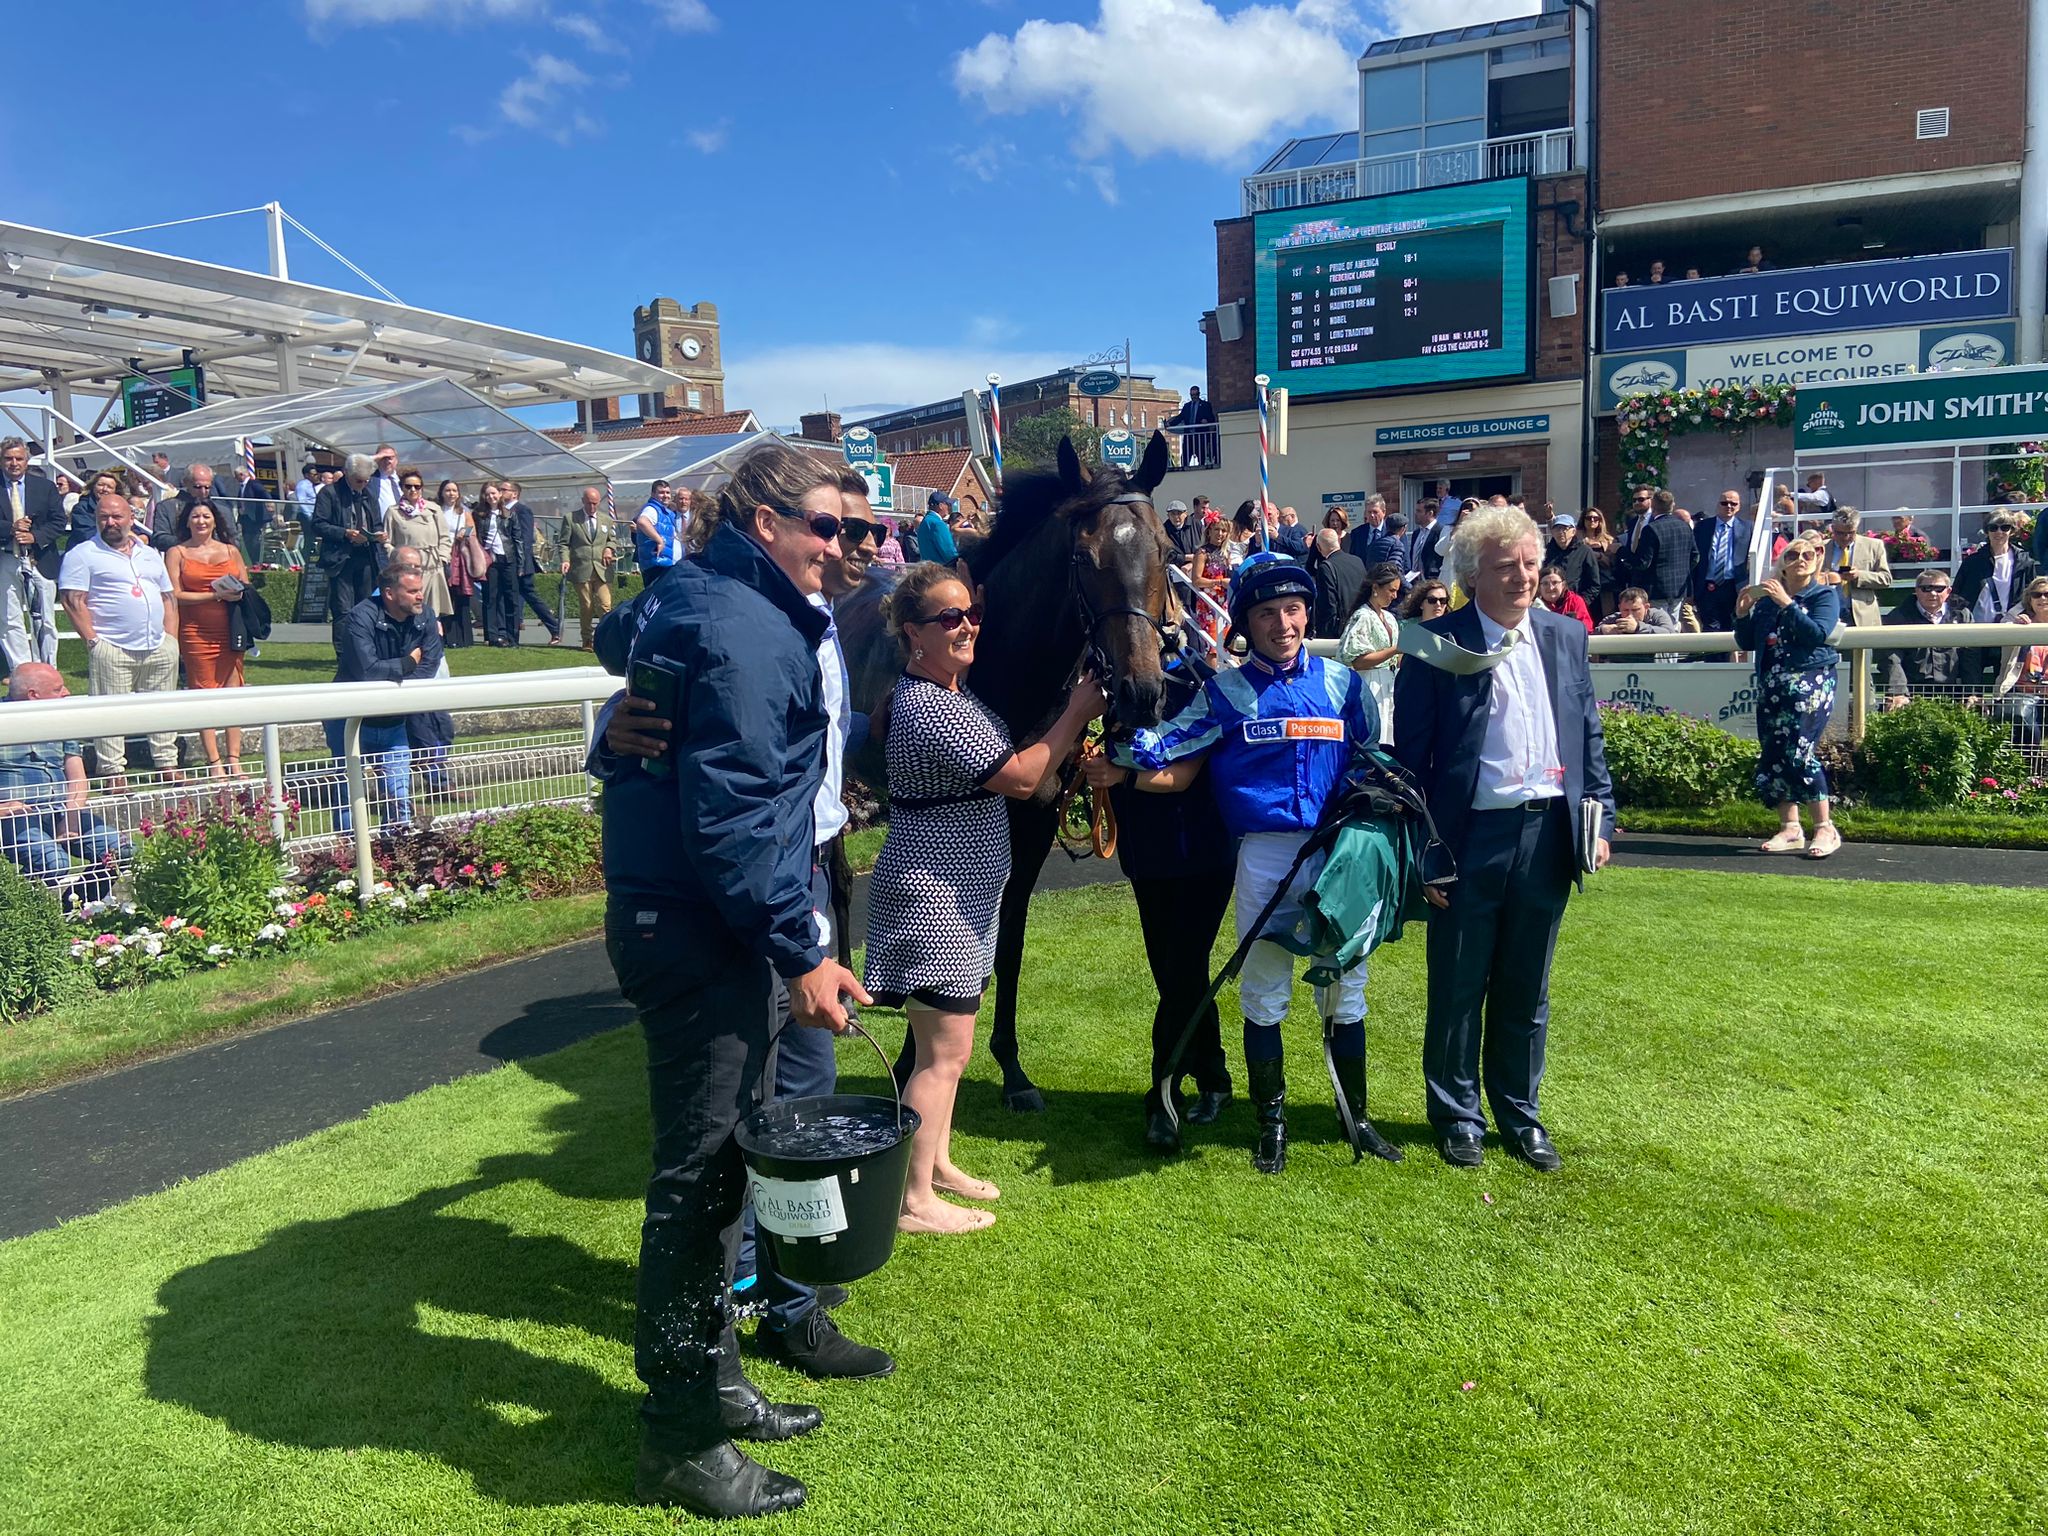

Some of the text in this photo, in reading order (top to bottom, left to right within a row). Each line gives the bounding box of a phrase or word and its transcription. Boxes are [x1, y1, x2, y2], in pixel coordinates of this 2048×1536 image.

[1275, 237, 1289, 248] JOHN
[1291, 233, 1315, 246] SMITH'S
[1316, 232, 1327, 243] CUP
[1330, 227, 1359, 240] HANDICAP
[1376, 241, 1396, 252] RESULT
[1292, 267, 1302, 277] 1ST
[1316, 265, 1321, 274] 3
[1329, 262, 1345, 272] PRIDE
[1346, 261, 1354, 270] OF
[1354, 258, 1379, 269] AMERICA
[1329, 269, 1375, 283] FREDERICK LARSON
[1291, 291, 1303, 301] 2ND
[1330, 286, 1347, 296] ASTRO
[1348, 284, 1361, 294] KING
[1291, 306, 1303, 315] 3RD
[1313, 303, 1320, 312] 13
[1329, 300, 1355, 311] HAUNTED
[1356, 297, 1375, 308] DREAM
[1614, 271, 2001, 332] AL BASTI EQUIWORLD
[1292, 307, 1417, 329] 4TH 14 NOBEL 12-1
[1292, 334, 1303, 343] 5TH
[1330, 329, 1344, 339] LONG
[1345, 326, 1374, 338] TRADITION
[1291, 349, 1300, 358] CSF
[1422, 345, 1431, 354] FAV
[1432, 345, 1436, 353] 4
[1437, 343, 1447, 352] SEA
[1448, 342, 1458, 351] THE
[1458, 340, 1478, 350] CASPER
[1302, 359, 1309, 367] BY
[1729, 344, 1873, 369] WELCOME TO
[1698, 363, 1906, 392] YORK RACECOURSE
[1808, 410, 1838, 421] JOHN
[1856, 399, 1935, 426] JOHN
[1390, 419, 1534, 440] MELROSE CLUB LOUNGE
[1802, 418, 1845, 432] SMITH'S
[847, 443, 873, 454] York
[1106, 444, 1132, 455] York
[1608, 689, 1654, 702] JOHN
[1251, 722, 1339, 737] Class Personnel
[768, 1196, 830, 1213] AL BASTI
[769, 1207, 831, 1221] EQUIWORLD
